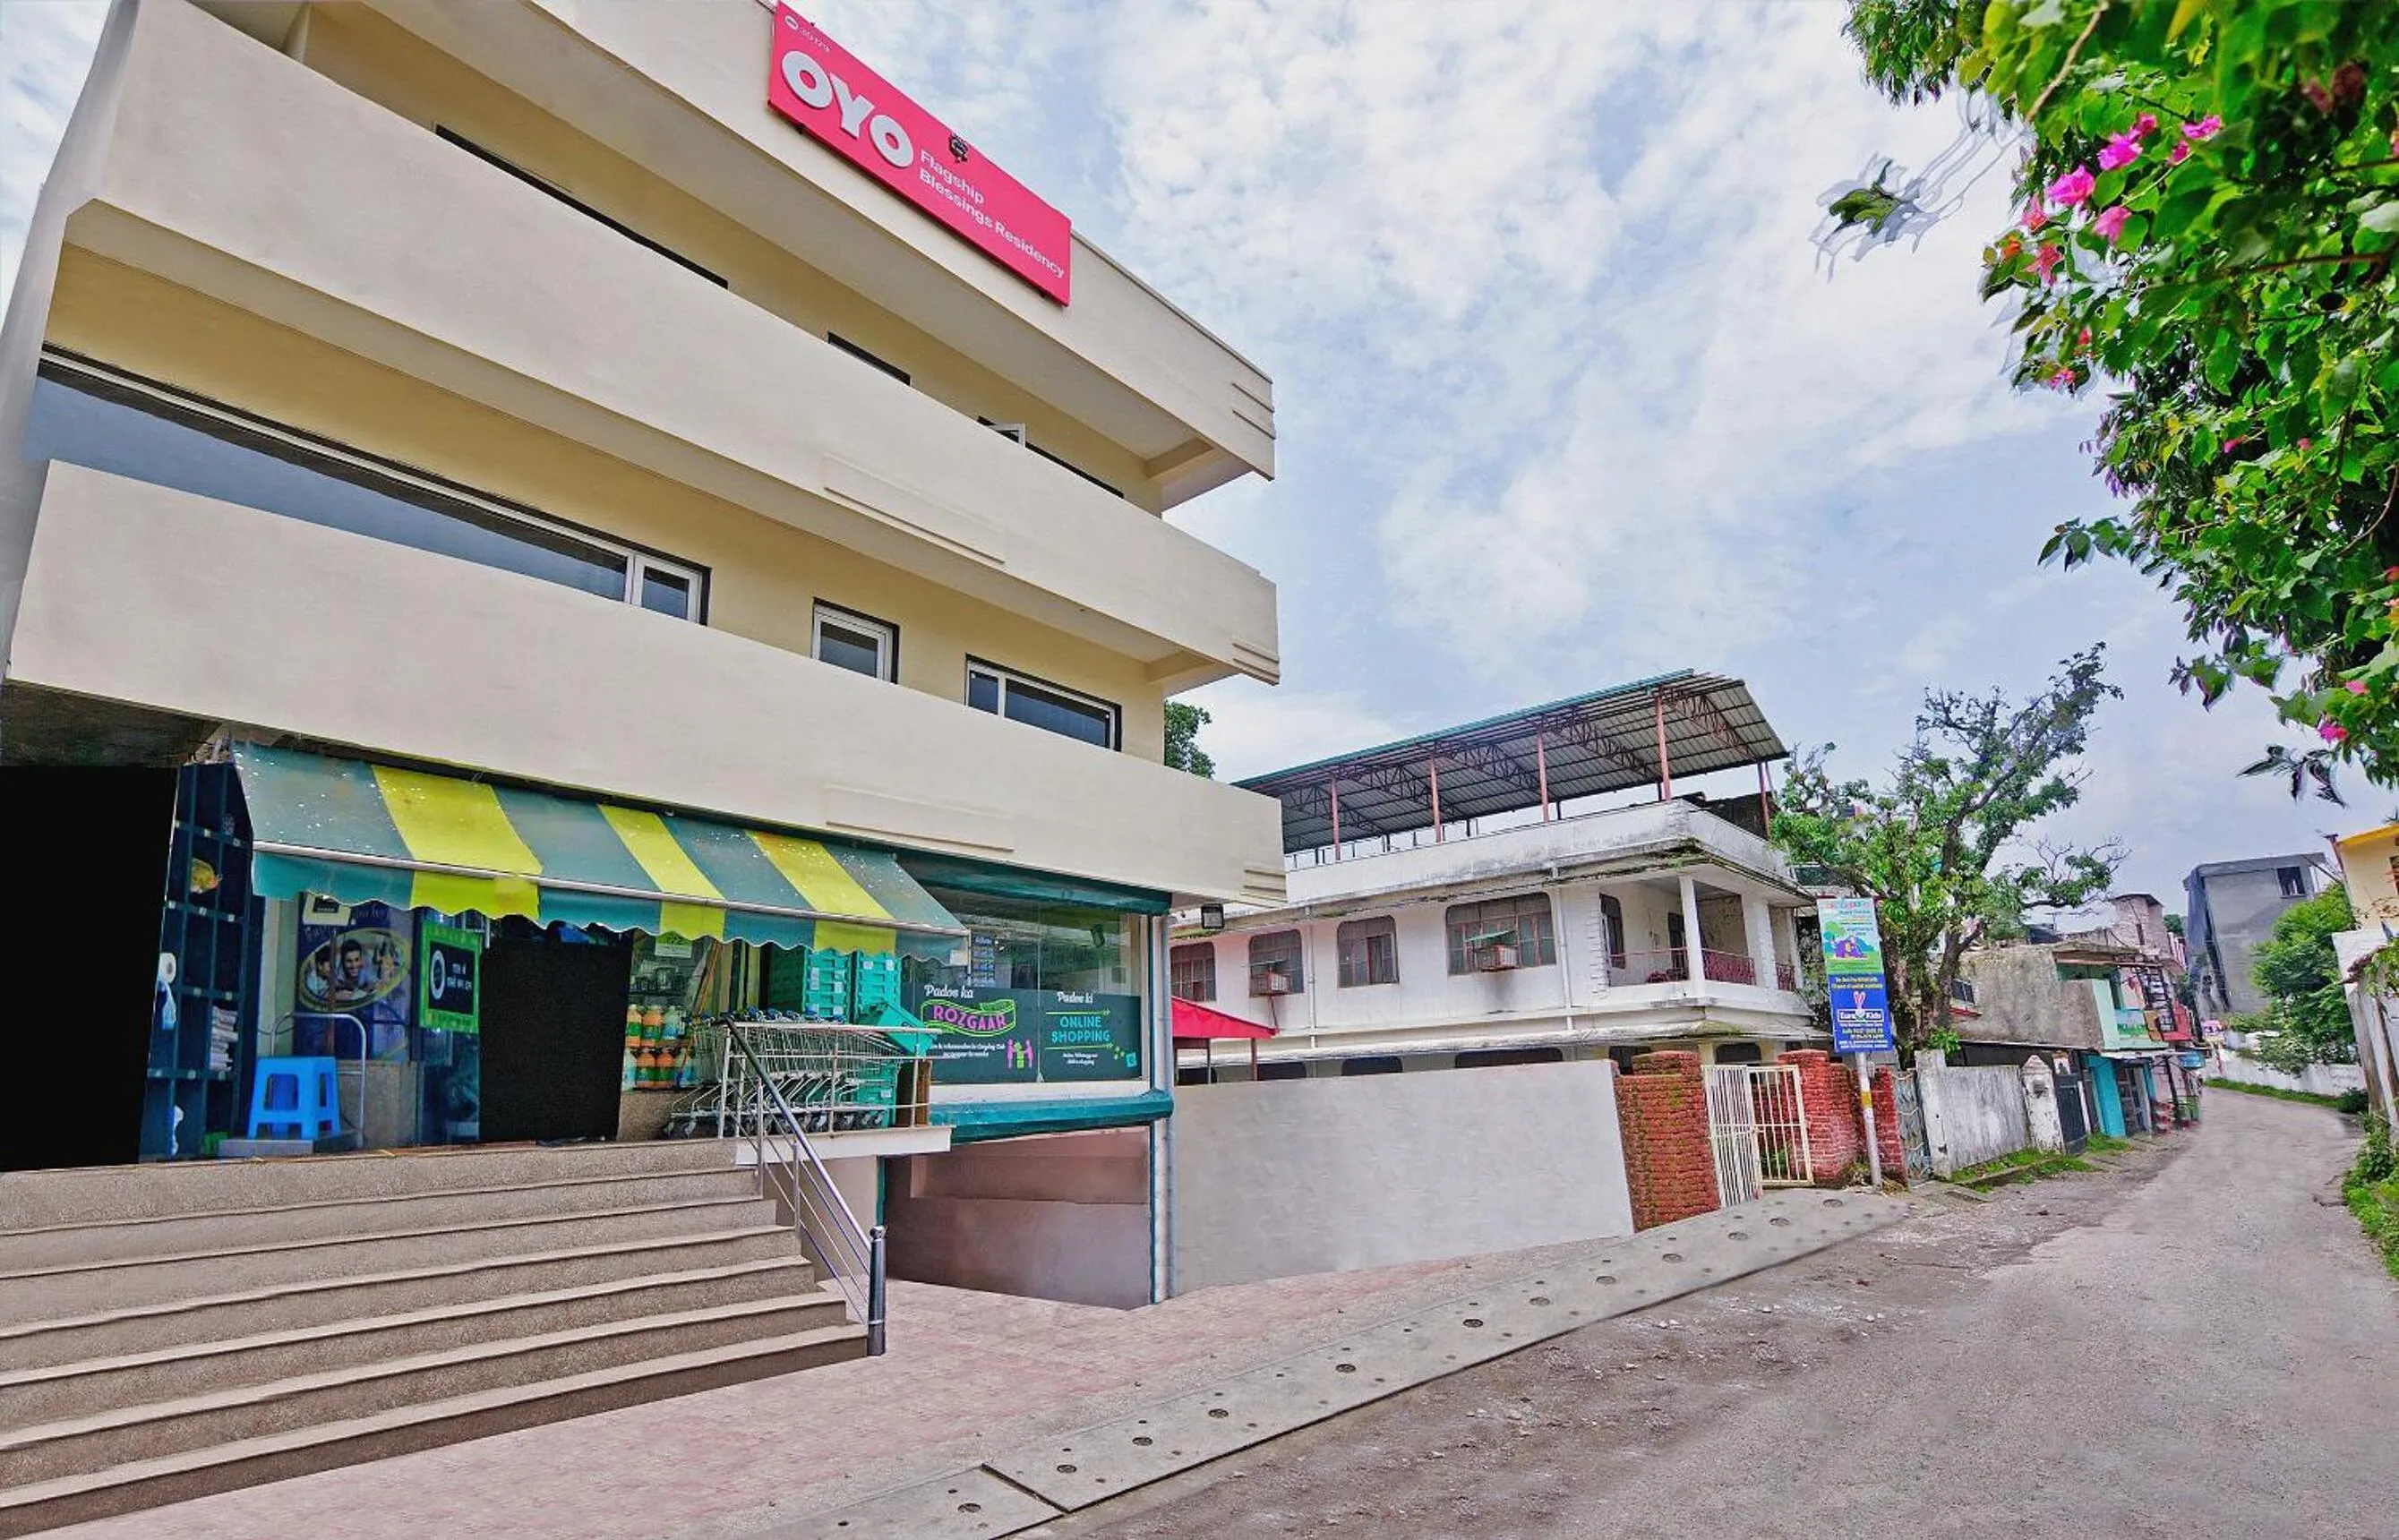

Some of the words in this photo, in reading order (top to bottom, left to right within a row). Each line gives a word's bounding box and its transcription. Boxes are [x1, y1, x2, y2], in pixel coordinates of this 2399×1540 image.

[781, 50, 914, 168] OYO
[920, 149, 985, 205] Flagship
[919, 167, 993, 229] Blessings
[995, 220, 1065, 278] Residency
[924, 984, 959, 997] Pados
[960, 985, 973, 998] ka
[932, 1005, 1007, 1030] ROZGAAR
[1059, 1016, 1102, 1028] ONLINE
[1051, 1030, 1110, 1043] SHOPPING
